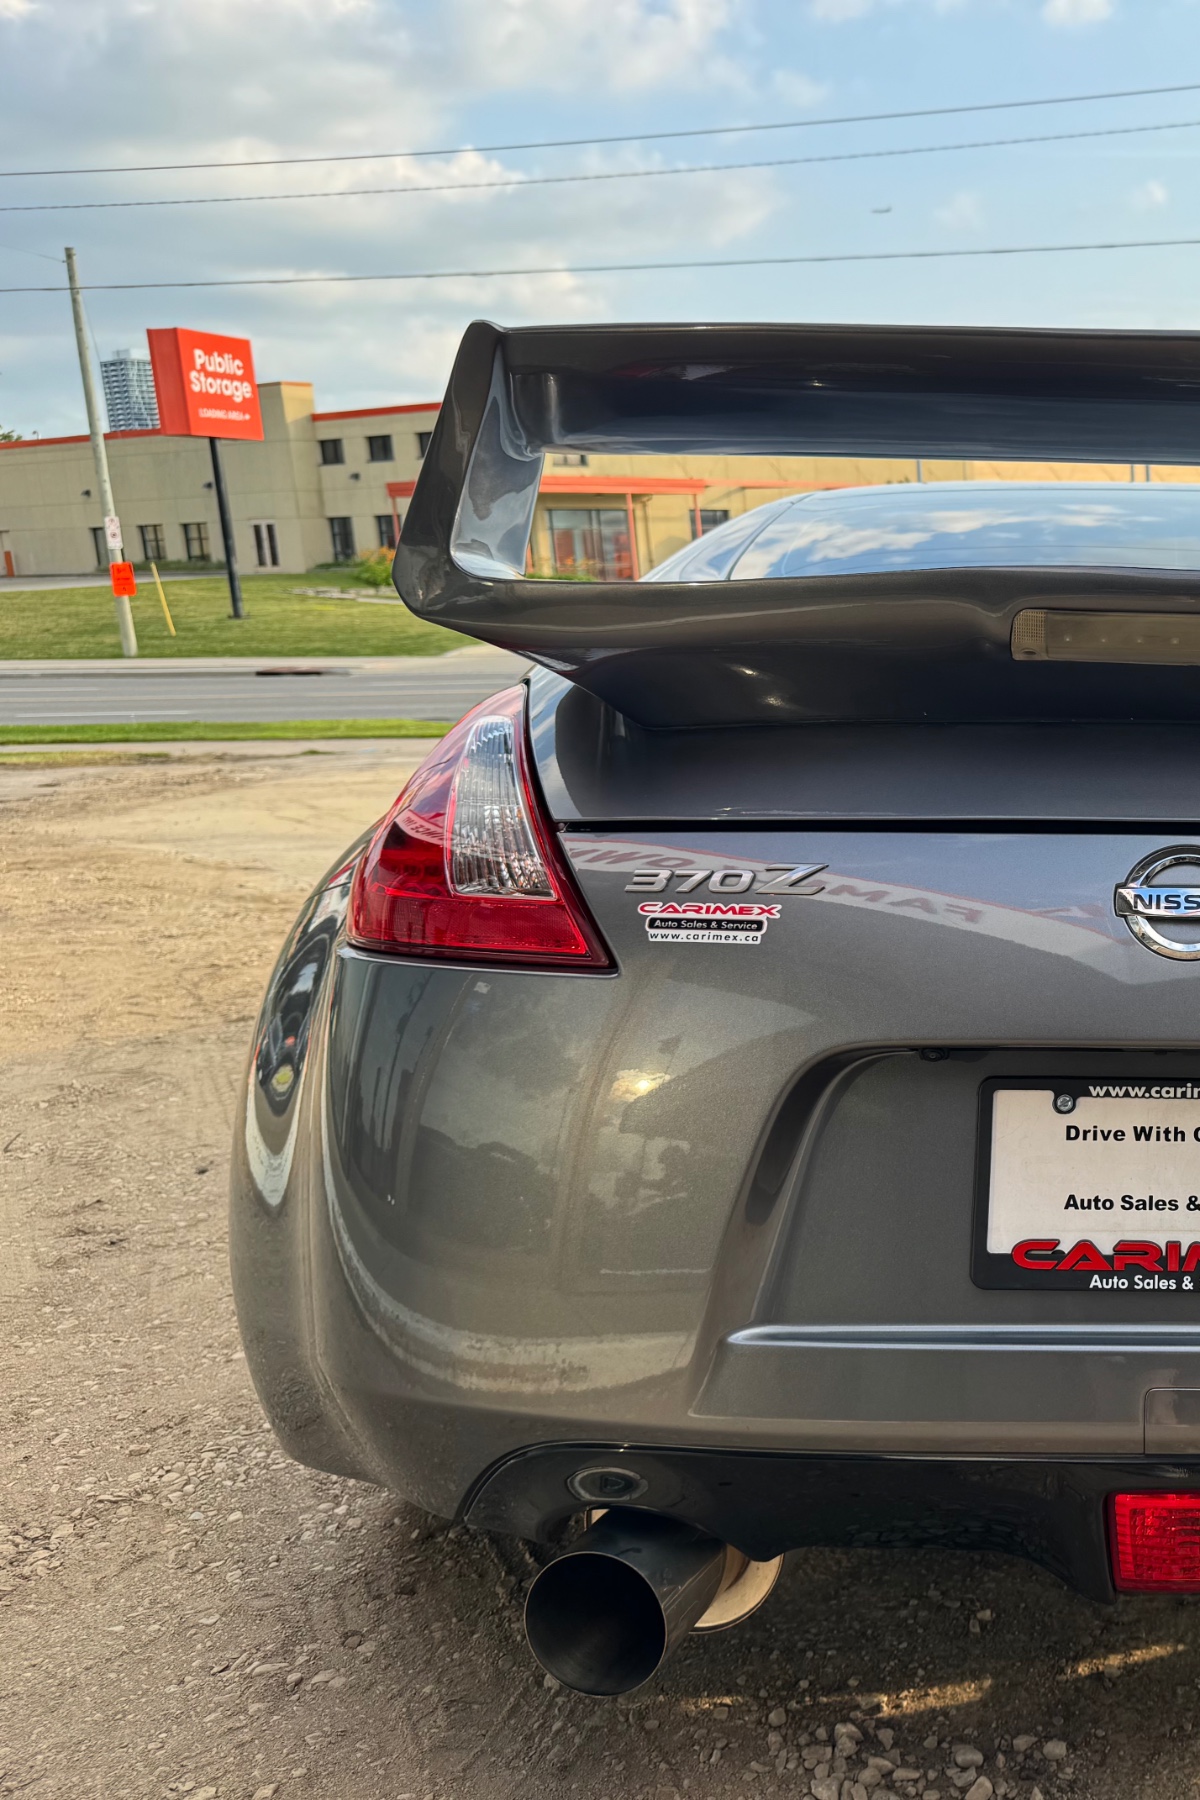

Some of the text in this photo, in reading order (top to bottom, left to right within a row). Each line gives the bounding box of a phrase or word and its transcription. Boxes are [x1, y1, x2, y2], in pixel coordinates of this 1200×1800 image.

[193, 348, 244, 376] Public
[190, 371, 252, 403] Storage
[624, 862, 830, 895] 370Z
[638, 903, 781, 917] CARIMEX
[653, 920, 758, 931] Auto Sales & Service
[649, 931, 760, 942] www.carimex.ca
[1065, 1125, 1126, 1142] Drive
[1132, 1126, 1186, 1143] With
[1064, 1194, 1115, 1211] Auto
[1120, 1194, 1180, 1212] Sales
[1089, 1274, 1129, 1290] Auto
[1134, 1274, 1177, 1290] Sales
[1182, 1276, 1194, 1290] &
